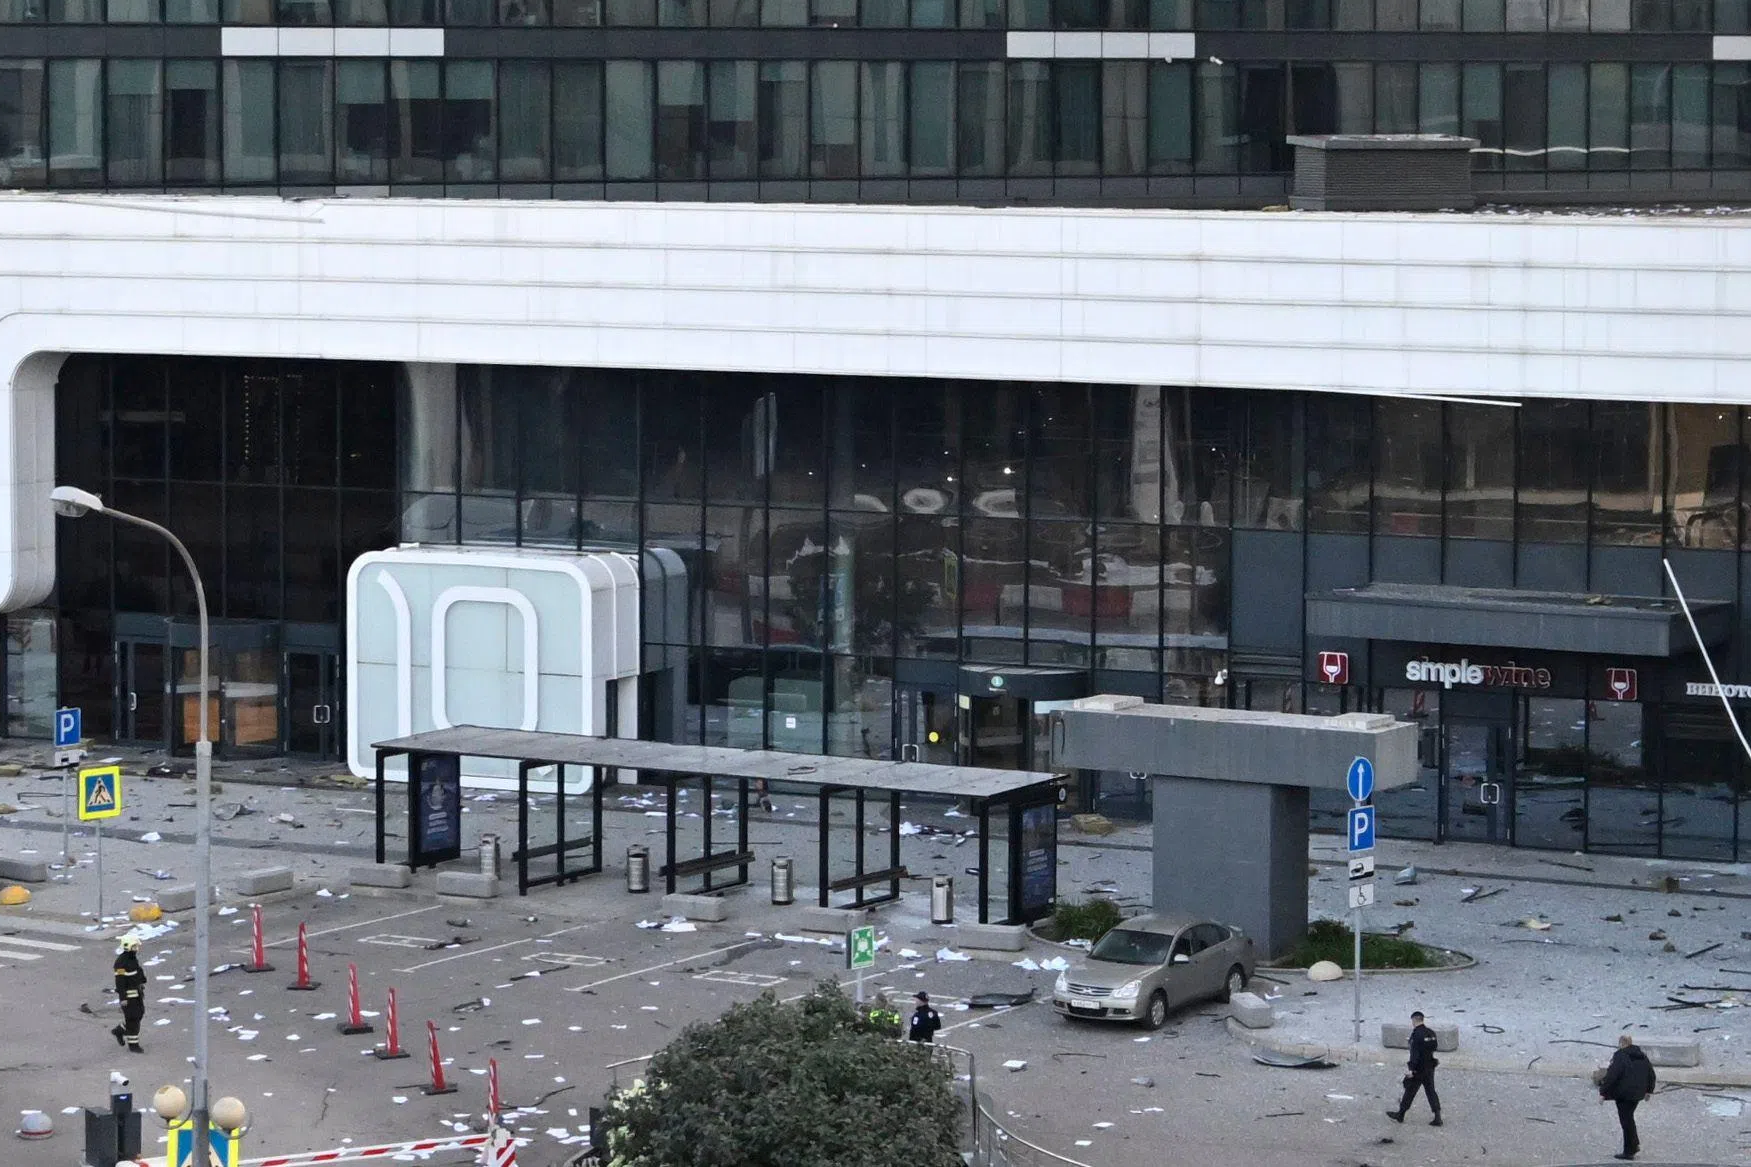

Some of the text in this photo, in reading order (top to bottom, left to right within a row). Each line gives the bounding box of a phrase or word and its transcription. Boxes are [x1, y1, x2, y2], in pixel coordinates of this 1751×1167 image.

[377, 569, 538, 736] 10
[60, 713, 75, 743] P
[1354, 812, 1369, 847] P
